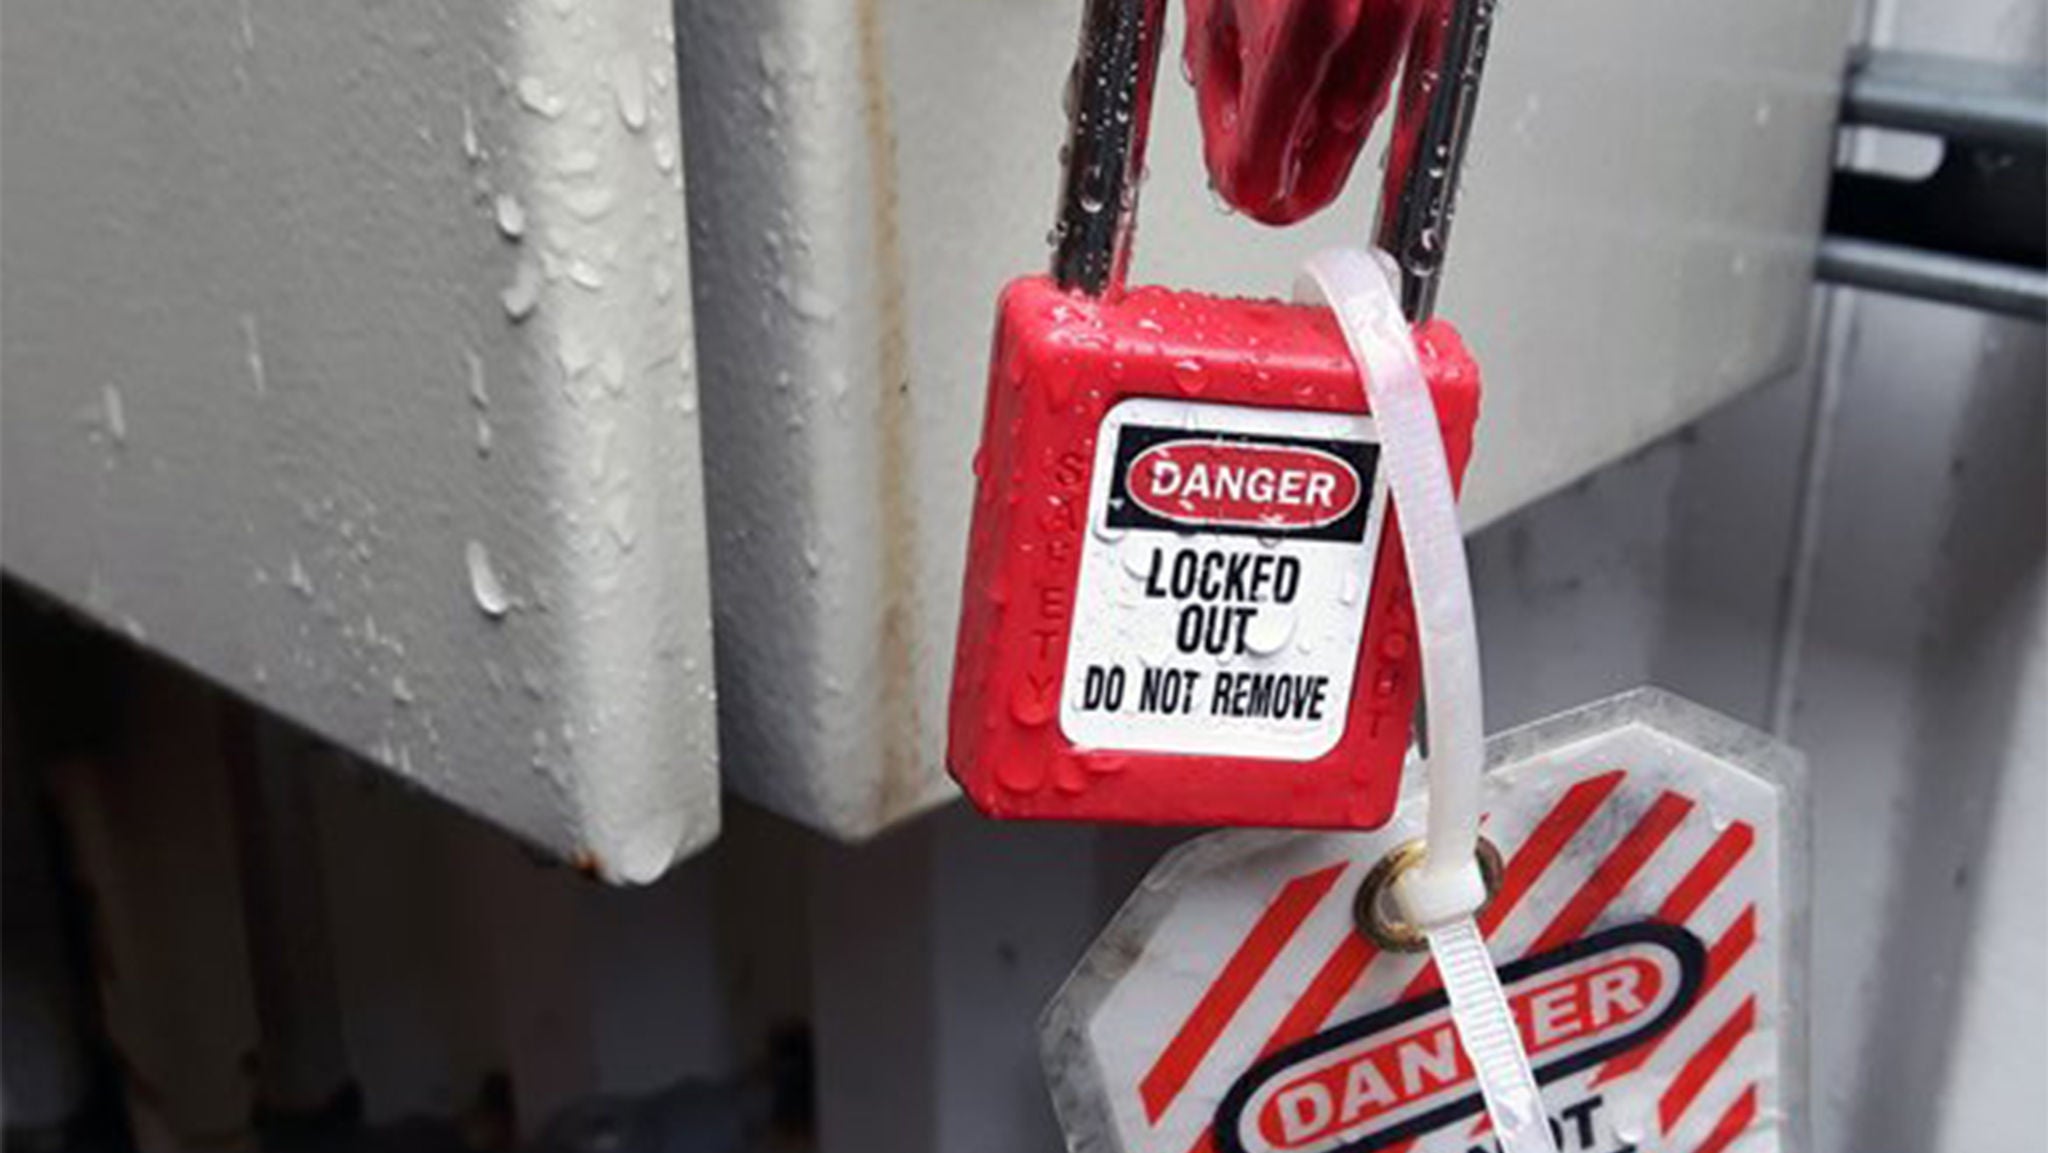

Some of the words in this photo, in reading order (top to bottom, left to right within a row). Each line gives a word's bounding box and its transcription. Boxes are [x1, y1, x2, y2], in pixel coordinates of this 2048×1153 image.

[1151, 460, 1336, 508] DANGER
[1145, 547, 1301, 604] LOCKED
[1176, 603, 1258, 655] OUT
[1082, 665, 1126, 711] DO
[1138, 667, 1200, 715] NOT
[1210, 671, 1329, 720] REMOVE
[1275, 965, 1645, 1144] DANER
